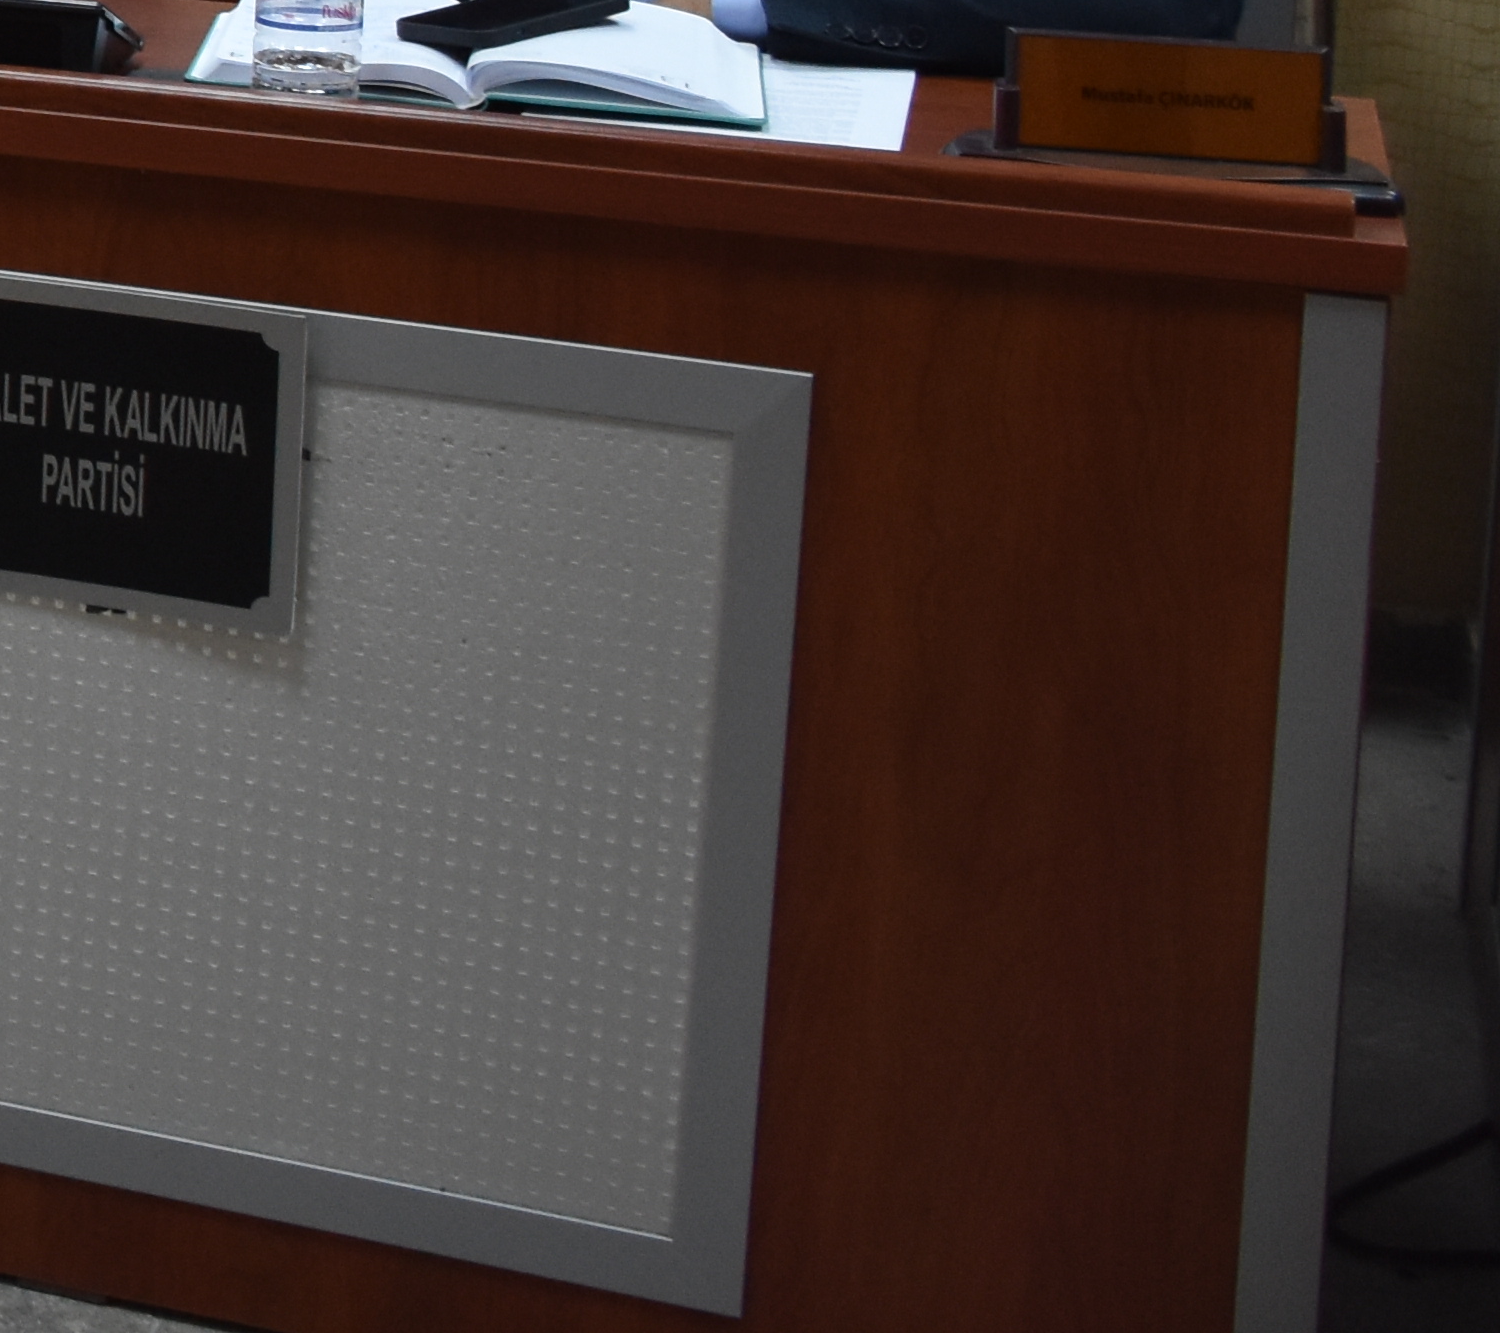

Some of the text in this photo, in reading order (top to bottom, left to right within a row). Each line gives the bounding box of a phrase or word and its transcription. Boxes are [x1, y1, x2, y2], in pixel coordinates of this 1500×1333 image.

[1081, 86, 1155, 105] Mustafa
[61, 379, 96, 434] VE
[104, 387, 248, 457] KALKINMA
[40, 450, 146, 518] PARTİSİ
